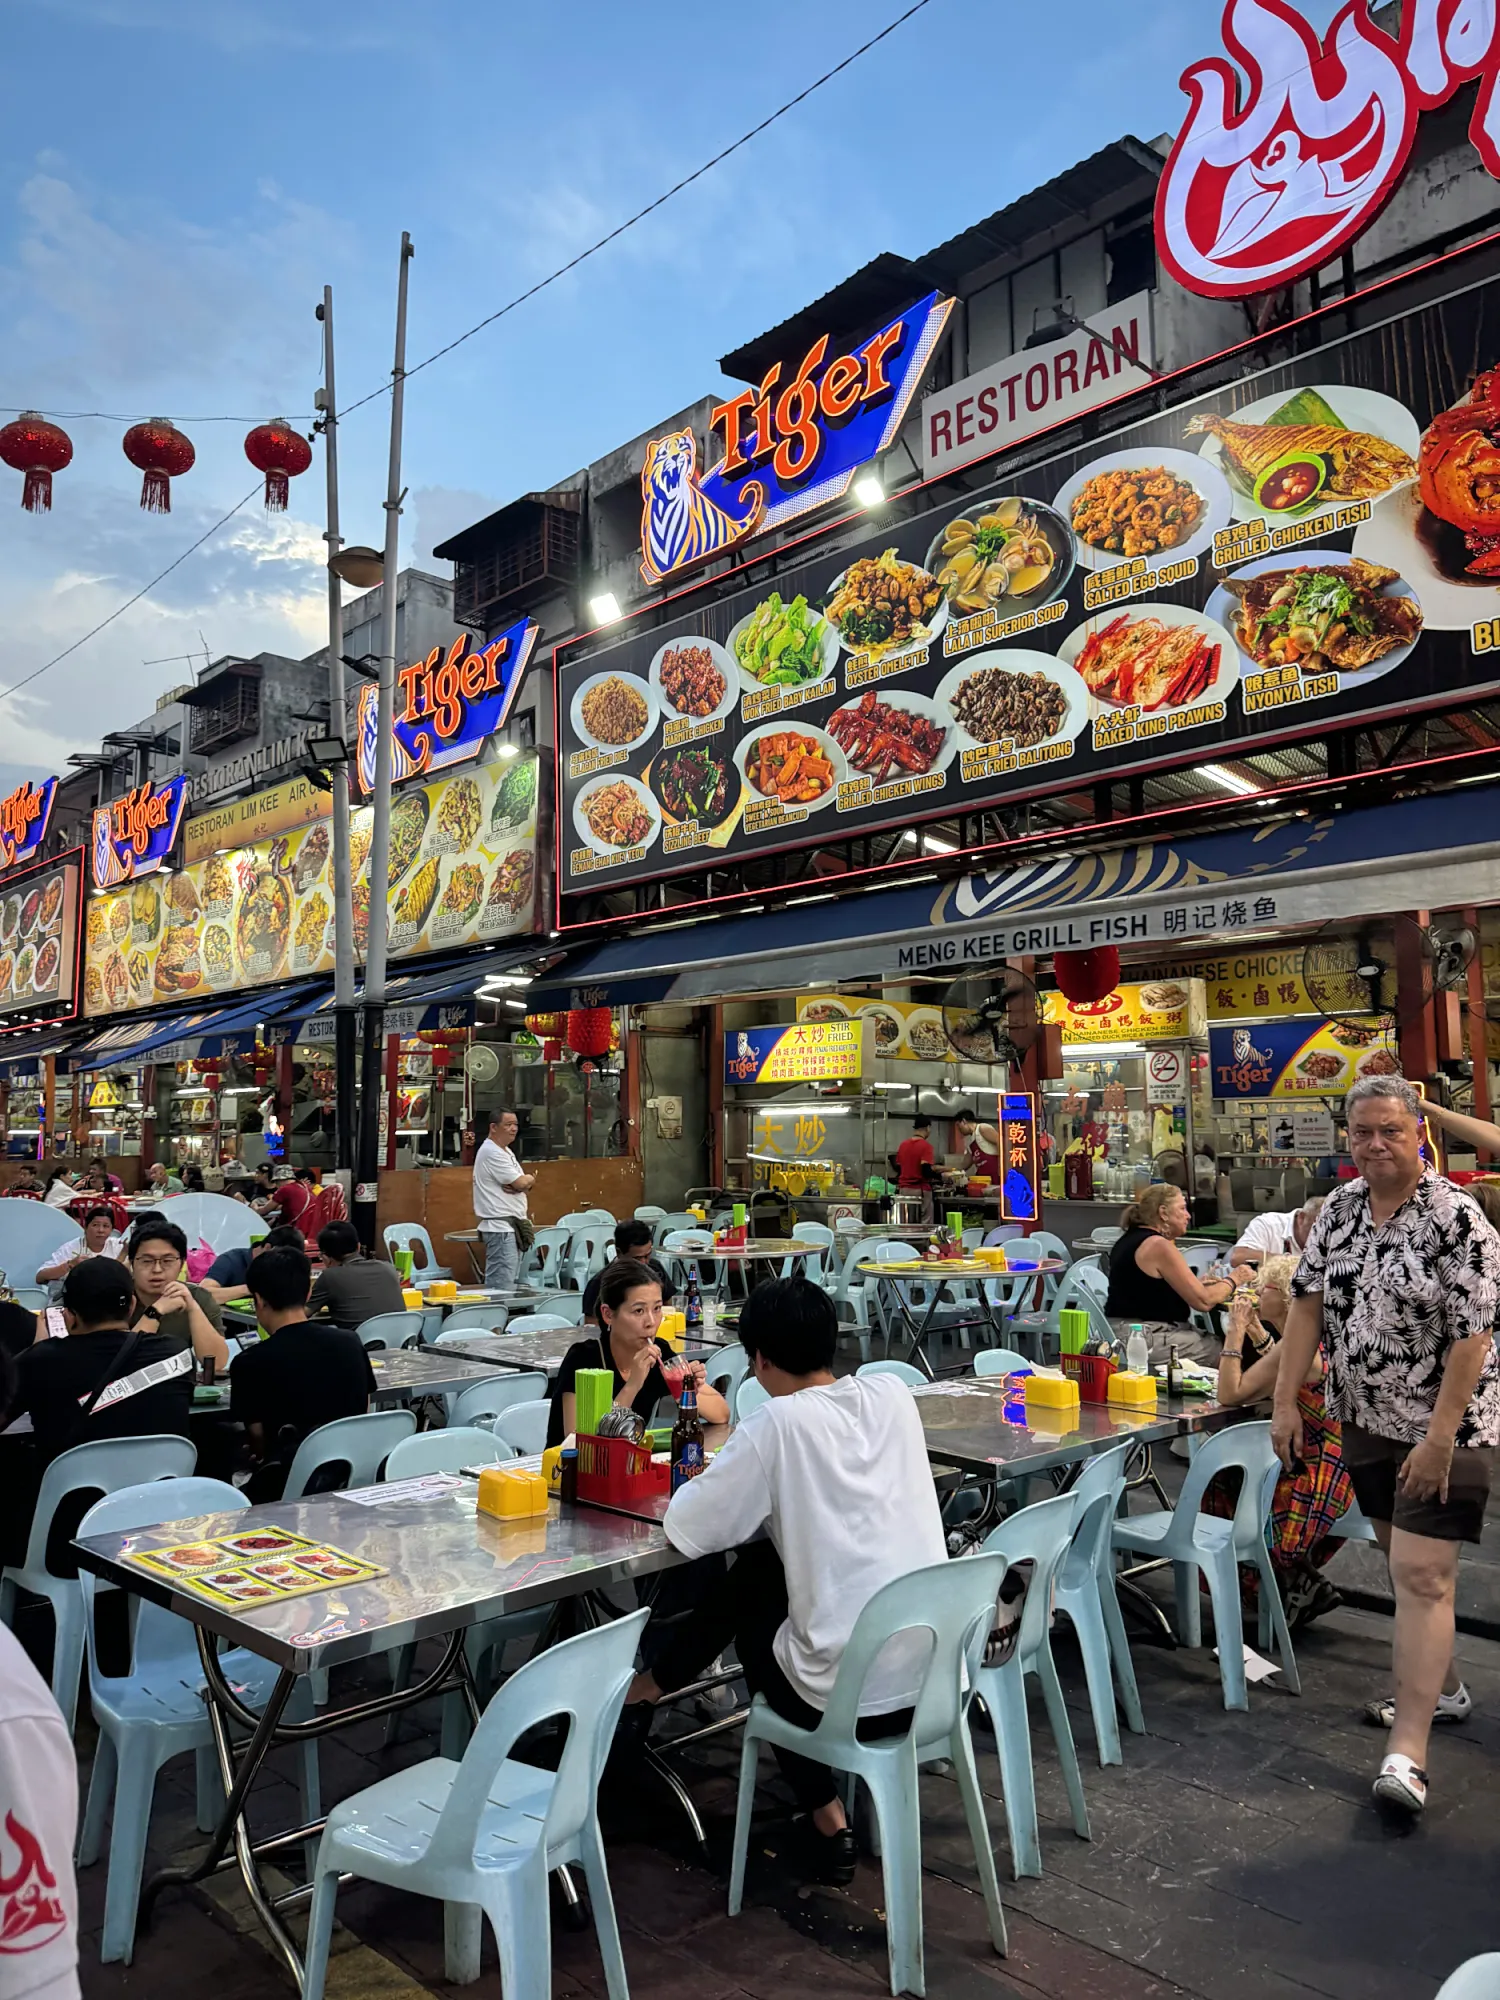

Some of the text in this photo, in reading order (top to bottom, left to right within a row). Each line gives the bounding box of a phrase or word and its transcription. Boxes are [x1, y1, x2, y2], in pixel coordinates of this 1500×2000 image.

[709, 321, 905, 479] Tiger
[929, 318, 1140, 457] RESTORAN
[1214, 519, 1265, 549] 烧鸡鱼
[1214, 502, 1371, 566] GRILLED CHICKEN FISH
[1085, 559, 1146, 591] 咸蛋鱿鱼
[1086, 561, 1196, 608] SALTED EGG SQUID
[945, 603, 1066, 654] LALA IN SUPERIOR SOUP
[398, 633, 507, 737] Tiger
[847, 651, 927, 687] OYSTER OMELETTE
[1245, 667, 1298, 693] 娘惹鱼
[743, 680, 834, 721] WOK FRIED BABY KAILAN
[1245, 675, 1337, 712] NYONYA FISH
[665, 718, 724, 747] MARMITE CHICKEN
[1095, 707, 1140, 731] 大头虾
[1095, 704, 1224, 748] BAKED KING PRAWNS
[186, 752, 259, 802] RESTORAN
[261, 736, 291, 773] LIM
[597, 755, 613, 769] FRIED
[614, 749, 628, 762] RICE
[962, 741, 1073, 781] WOK FRIED BALITONG
[838, 773, 944, 810] GRILLED CHICKEN WINGS
[2, 780, 44, 844] Tiger
[113, 781, 172, 854] Tiger
[188, 810, 234, 841] RESTORAN
[241, 801, 257, 821] LIM
[259, 793, 279, 815] KEE
[288, 782, 307, 803] AIR
[745, 811, 763, 823] SWEET
[770, 805, 785, 818] SOUR
[778, 809, 808, 825] BEANCURD
[628, 846, 646, 861] TEOW
[664, 828, 710, 850] SIZZLING BEEF
[1163, 896, 1278, 934] 明记烧鱼
[899, 914, 1148, 968] MENG KEE GRILL FISH
[581, 986, 609, 1007] Tiger
[794, 1026, 825, 1044] 大炒
[828, 1032, 854, 1043] FRIED
[830, 1023, 850, 1032] STIR
[1073, 1029, 1118, 1037] HAINANESE
[1121, 1026, 1159, 1034] CHICKEN
[728, 1057, 758, 1079] Tiger
[1217, 1064, 1272, 1092] Tiger
[755, 1115, 827, 1156] 大炒
[1008, 1121, 1028, 1168] 乾杯
[678, 1464, 705, 1480] Tiger
